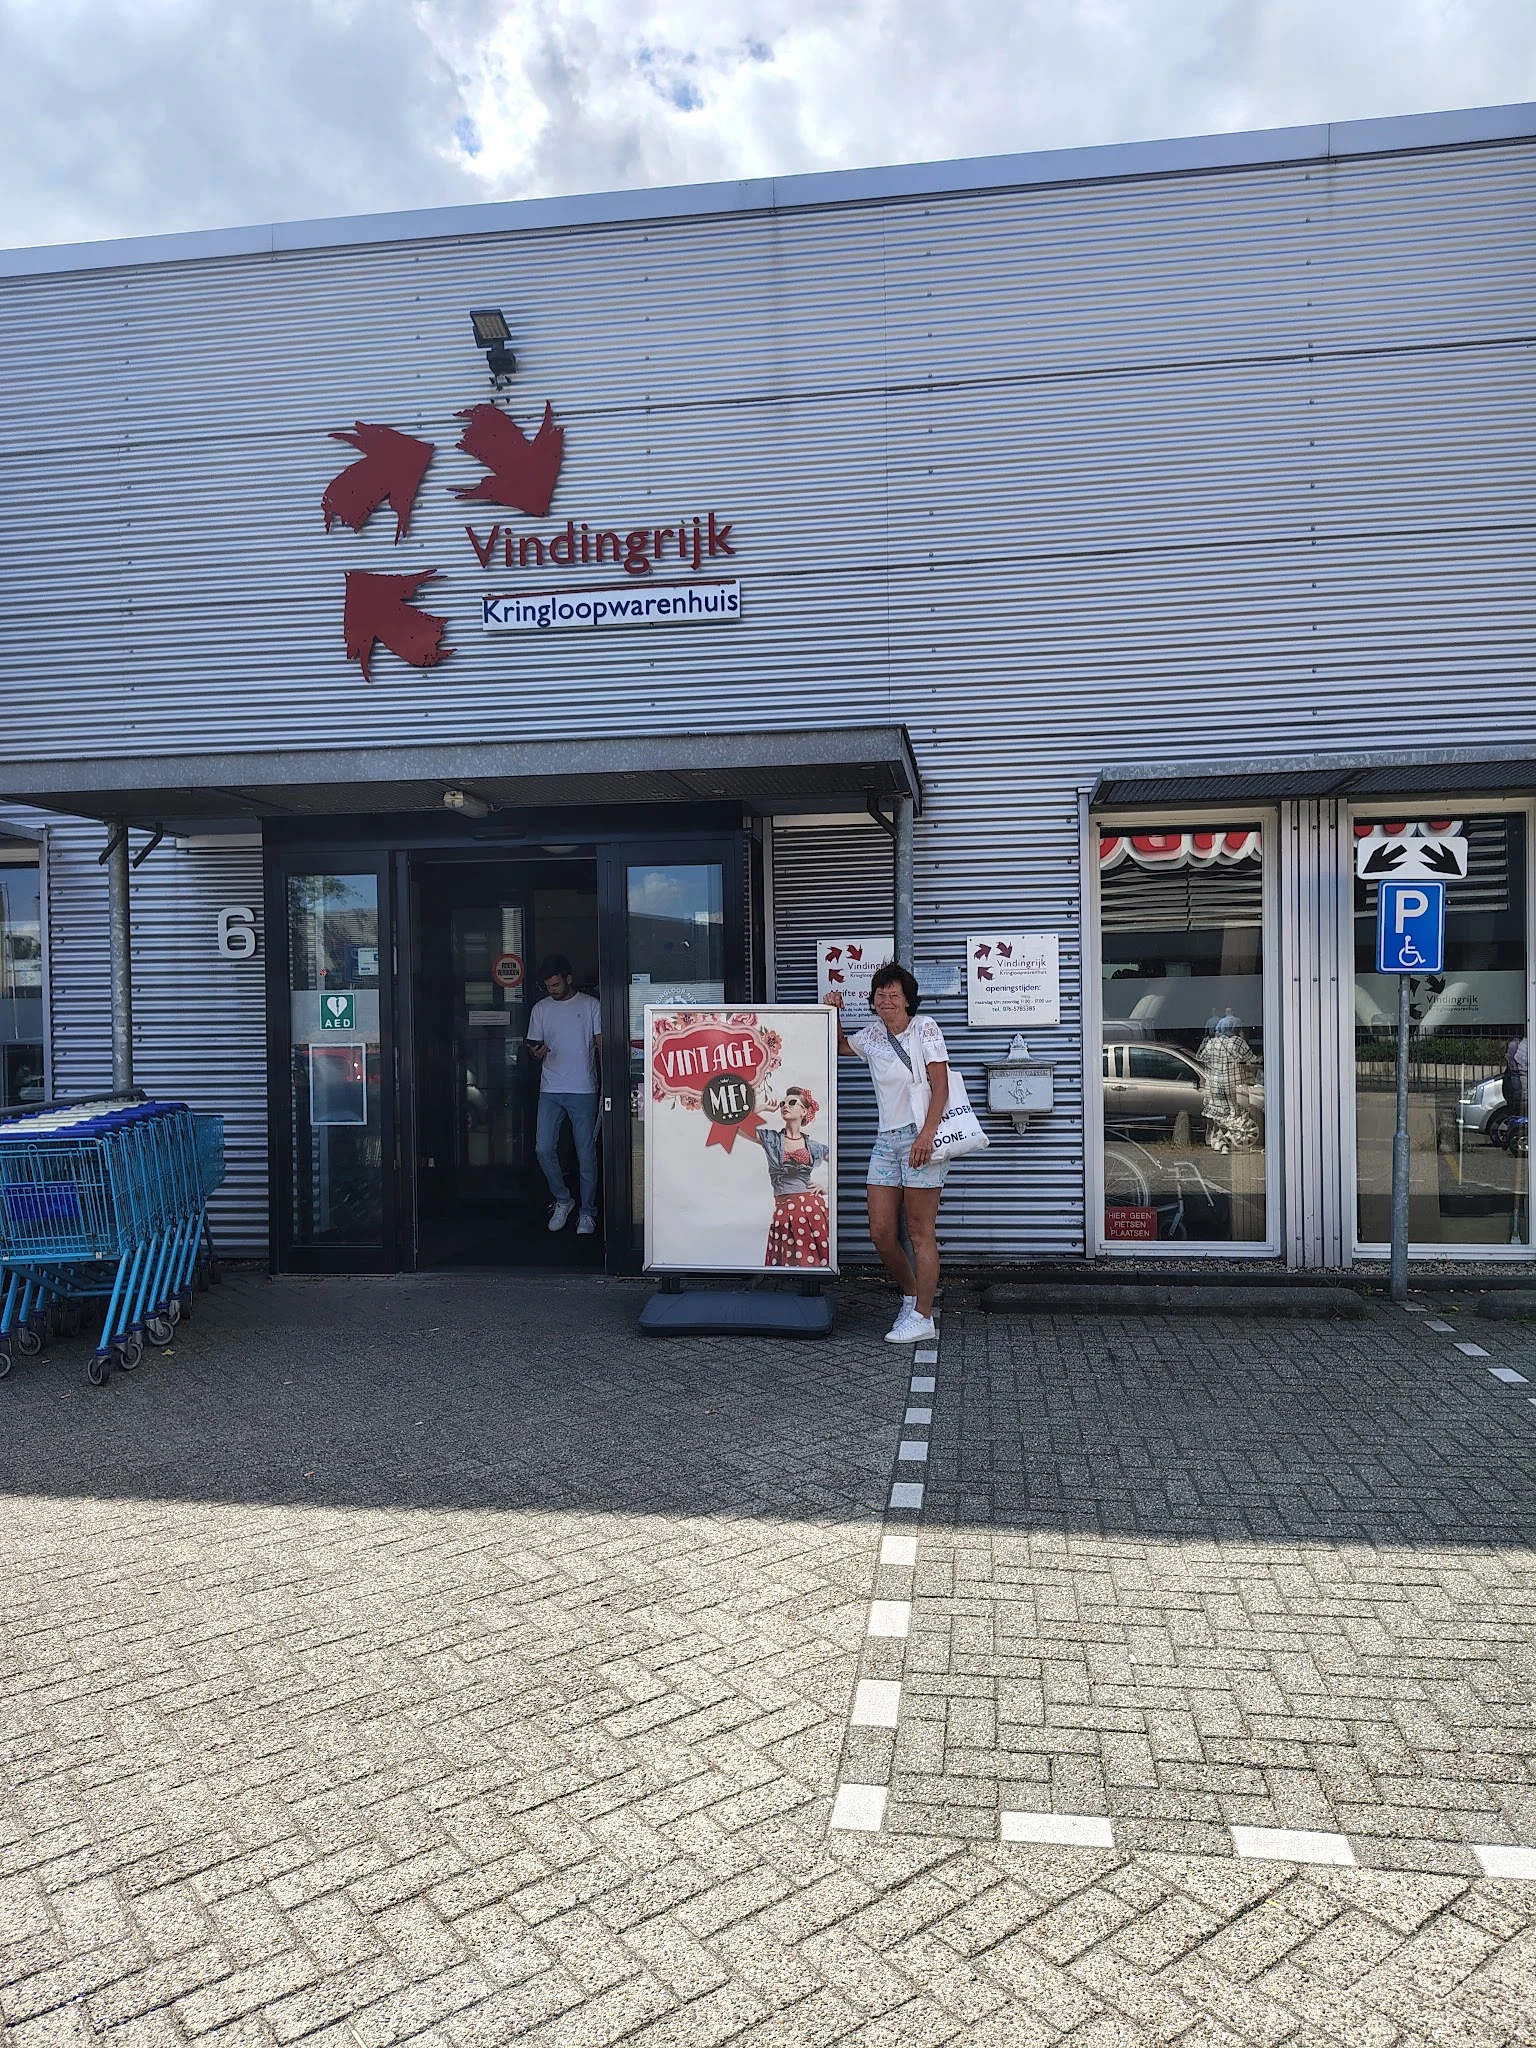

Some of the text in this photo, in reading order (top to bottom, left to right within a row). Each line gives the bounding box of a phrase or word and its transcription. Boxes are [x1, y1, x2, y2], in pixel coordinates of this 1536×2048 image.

[465, 512, 736, 575] Vindingrijk
[483, 589, 739, 628] Kringloopwarenhuis
[1395, 889, 1429, 934] P
[217, 906, 256, 959] 6
[996, 958, 1047, 970] Vindingrijk
[985, 984, 1041, 994] openingstijden:
[1426, 994, 1478, 1006] Vindingrijk
[324, 1018, 351, 1028] AED
[660, 1039, 757, 1079] VINTAGE
[708, 1083, 750, 1116] ME!
[933, 1130, 967, 1148] DONE.
[1108, 1211, 1152, 1220] HIER GEEN
[1114, 1220, 1147, 1229] FIETSEN
[1110, 1229, 1150, 1237] PLAATSEN
